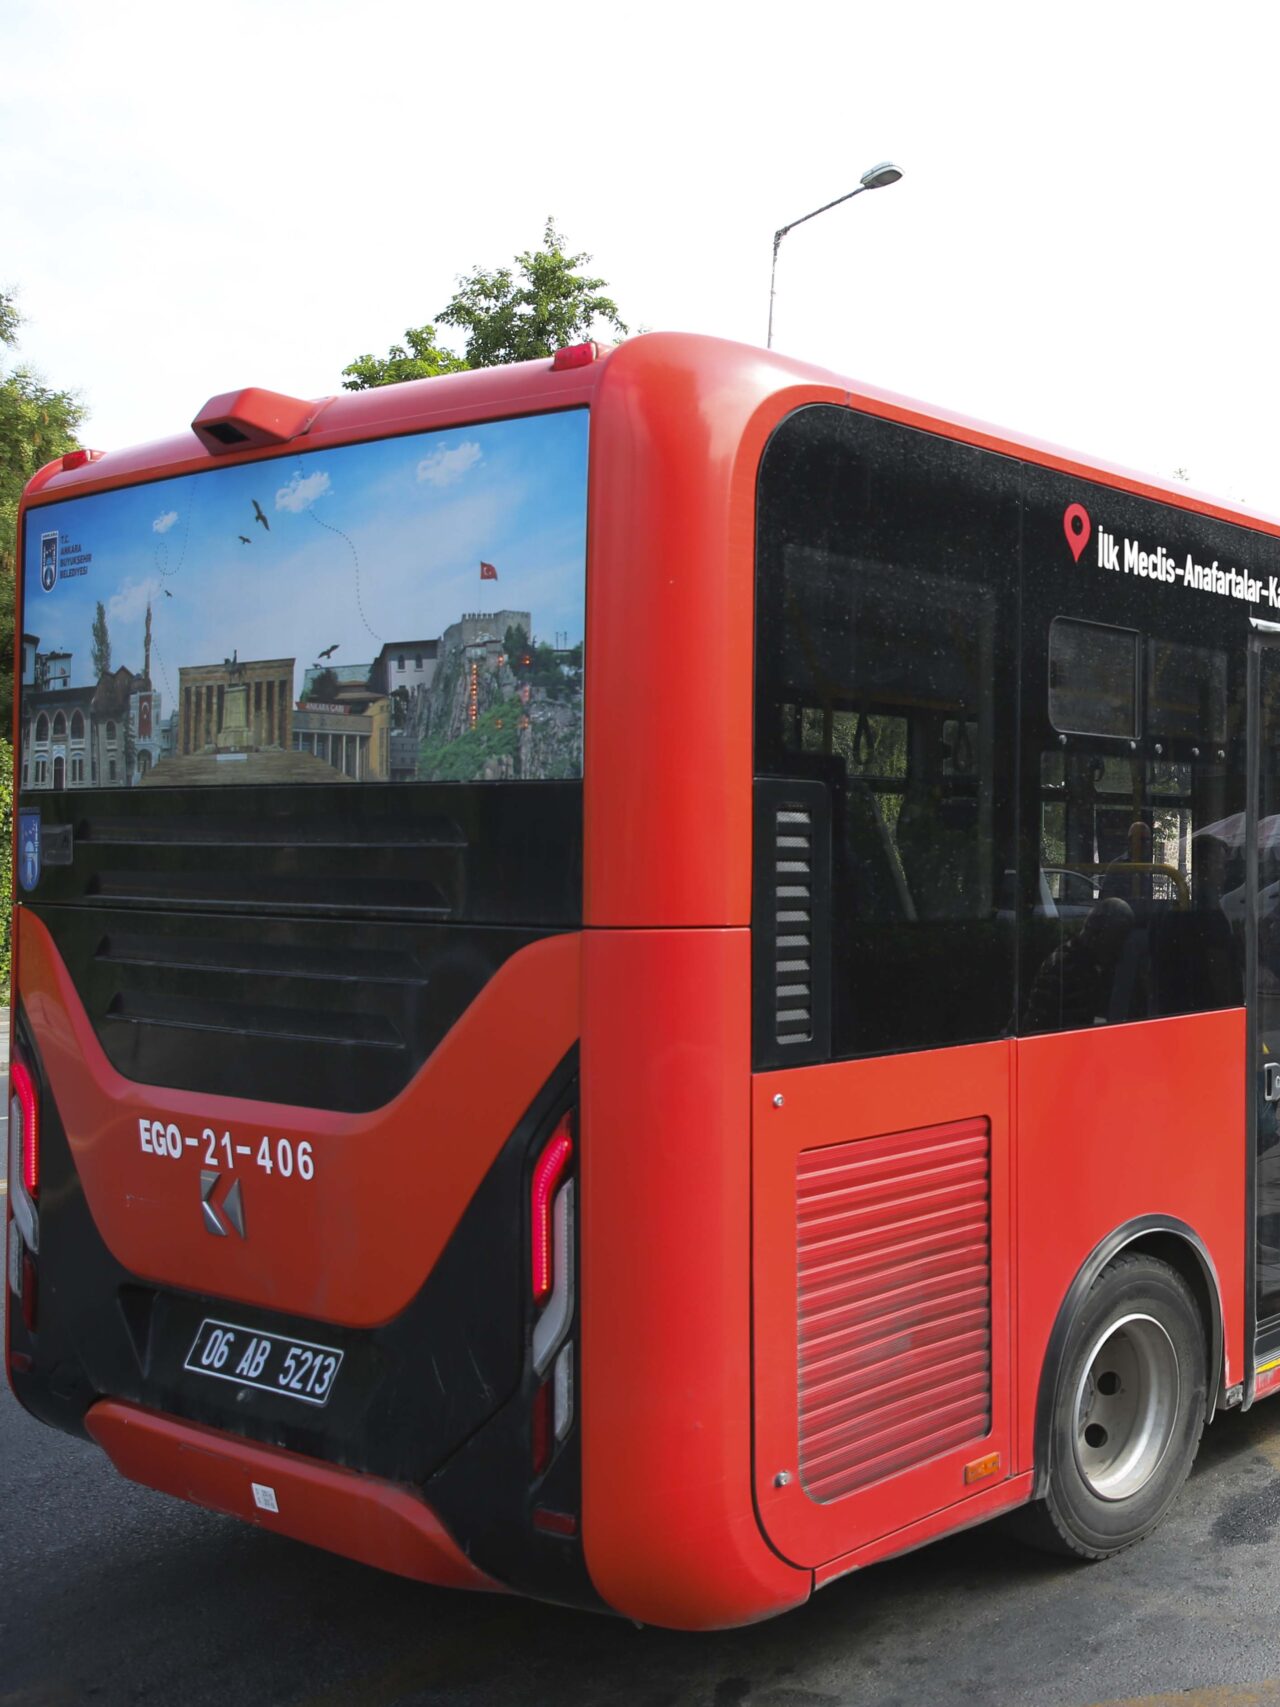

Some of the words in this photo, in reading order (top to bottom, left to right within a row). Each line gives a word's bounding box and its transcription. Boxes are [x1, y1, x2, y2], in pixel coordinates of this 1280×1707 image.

[1097, 525, 1120, 572] İlk
[138, 1118, 315, 1181] EGO-21-406
[201, 1328, 234, 1368] 06
[235, 1338, 270, 1380] AB
[278, 1347, 336, 1395] 5213
